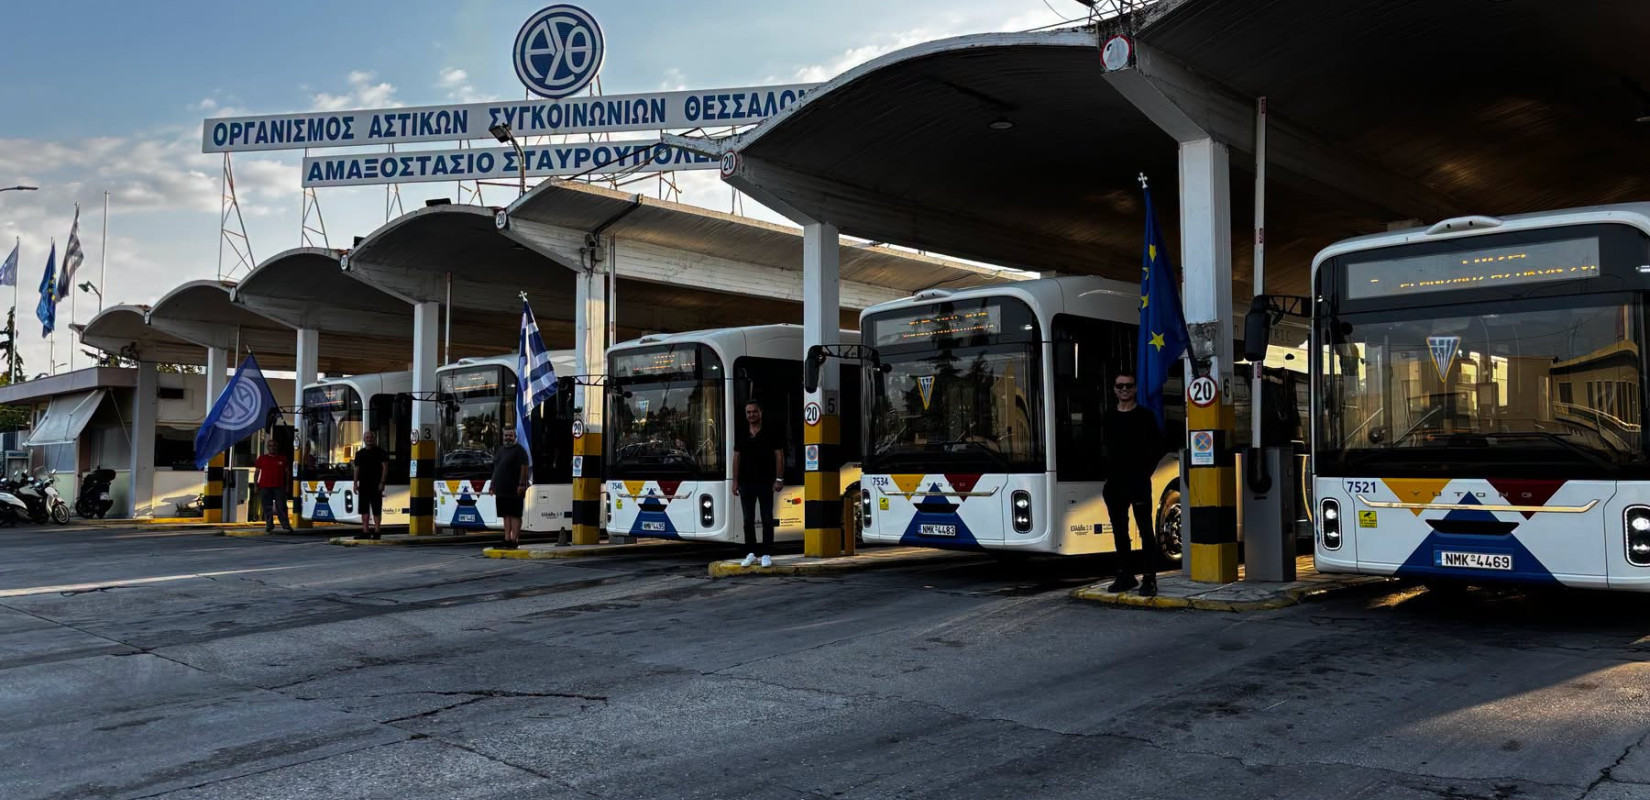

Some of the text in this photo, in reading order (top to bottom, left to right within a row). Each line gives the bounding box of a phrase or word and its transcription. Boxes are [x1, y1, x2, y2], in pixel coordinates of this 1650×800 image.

[213, 116, 355, 146] ΟΡΓΑΝΙΣΜΟΣ
[368, 109, 468, 139] ΑΣΤΙΚΩΝ
[488, 98, 666, 131] ΣΥΓΚΟΙΝΩΝΙΩΝ
[307, 143, 721, 182] ΑΜΑΞΟΣΤΑΣΙΟ ΣΤΑΥΡΟΥΠΟΛΕ
[723, 154, 734, 171] 20
[1193, 381, 1212, 401] 20
[1223, 378, 1230, 397] 6
[828, 397, 836, 413] 5
[806, 406, 818, 421] 20
[424, 428, 432, 440] 3
[872, 477, 889, 486] 7534
[1347, 481, 1376, 493] 7521
